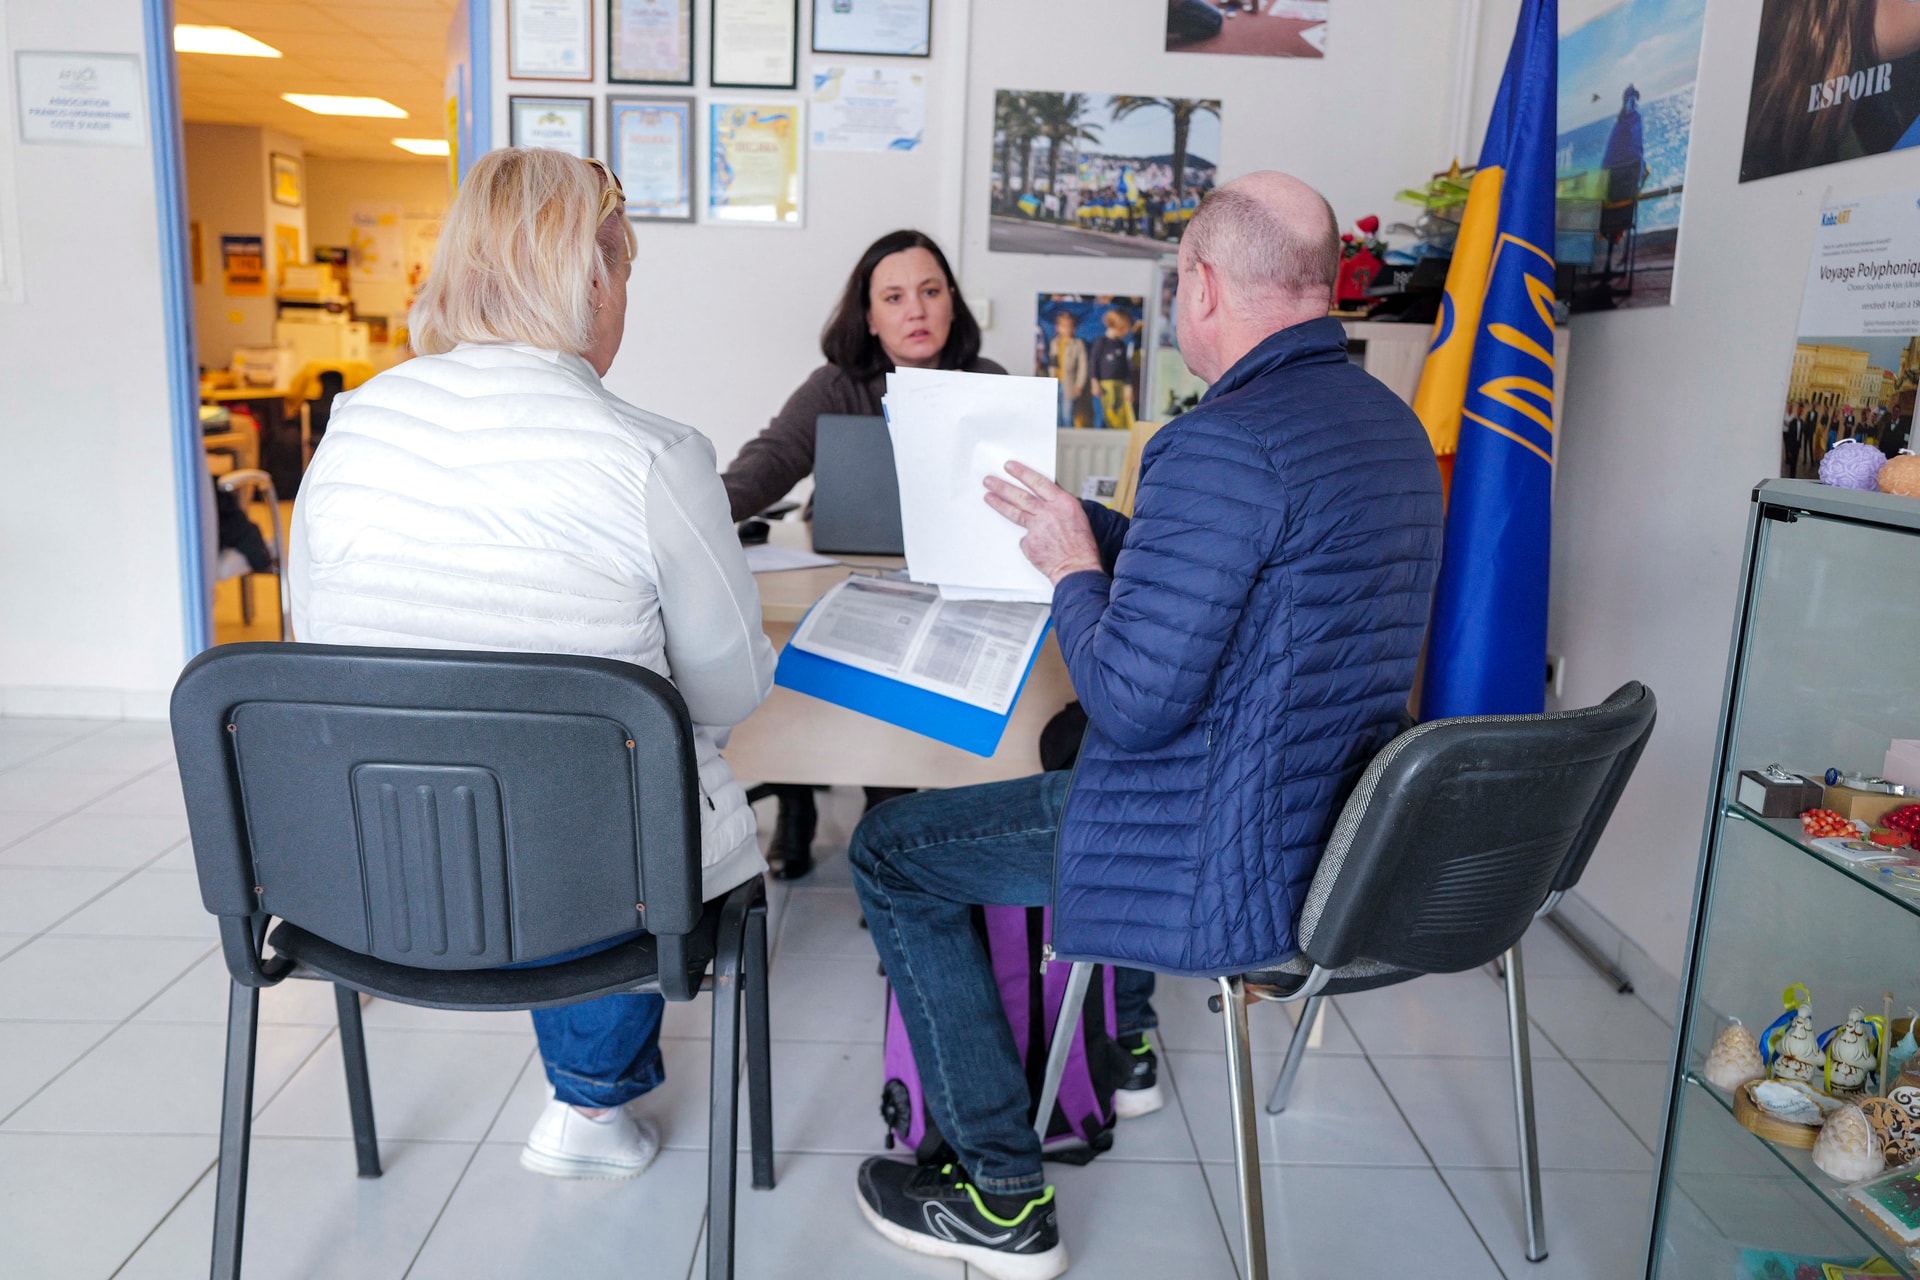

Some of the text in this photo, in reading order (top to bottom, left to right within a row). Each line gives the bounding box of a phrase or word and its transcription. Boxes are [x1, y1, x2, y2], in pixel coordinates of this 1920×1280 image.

[1807, 62, 1893, 113] ESPOIR
[1820, 264, 1855, 283] Voyage
[1861, 302, 1886, 310] vendredi
